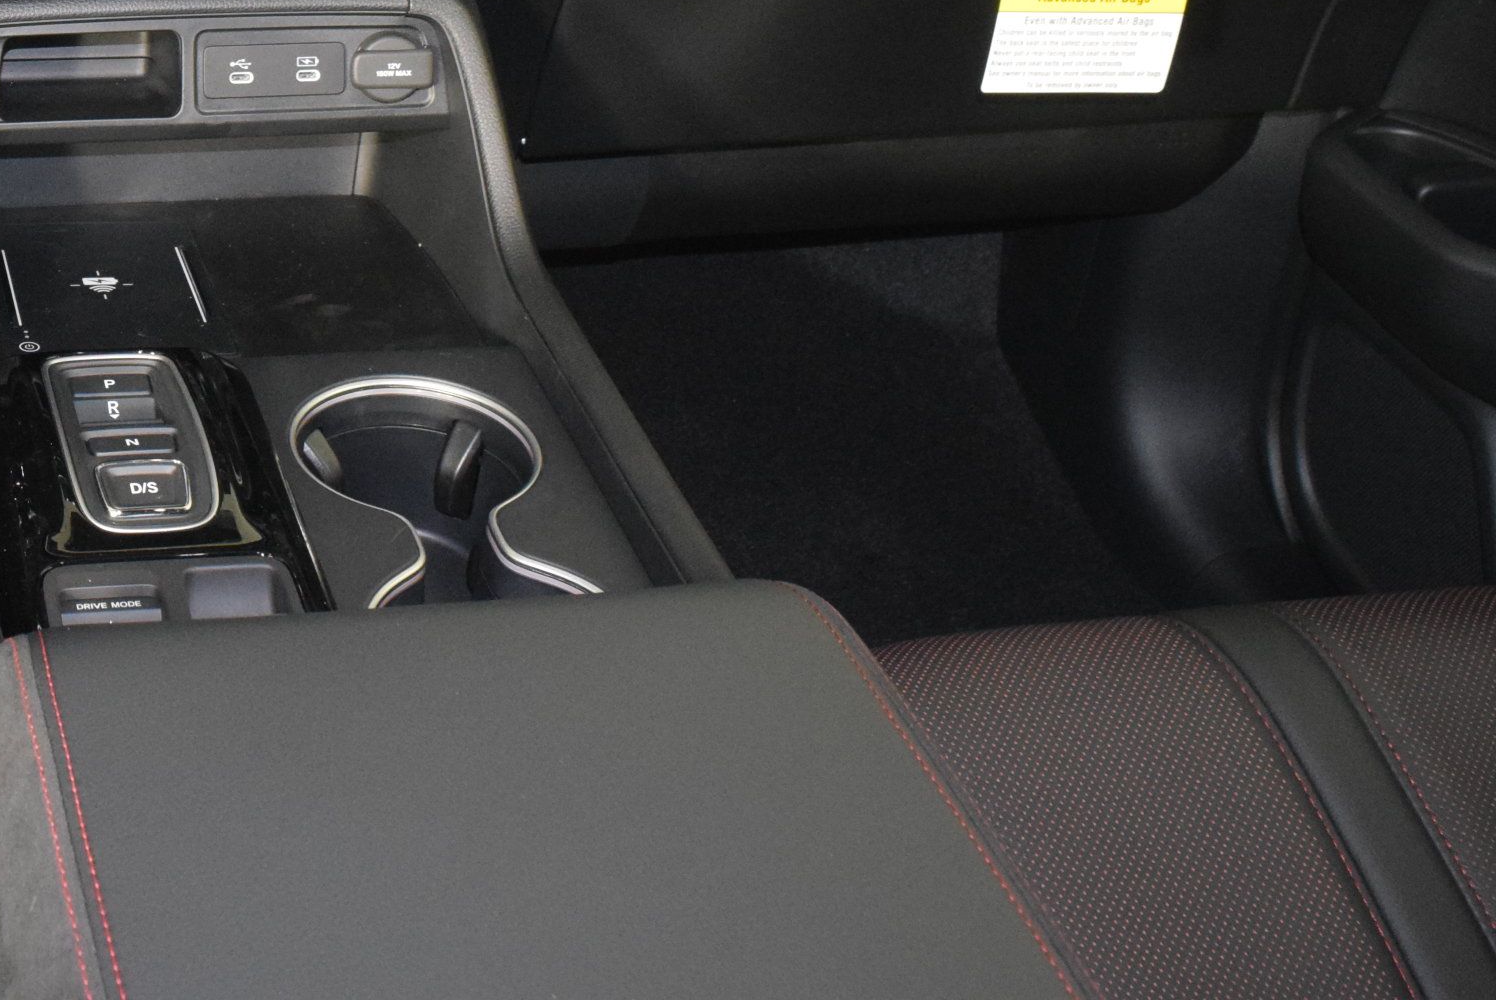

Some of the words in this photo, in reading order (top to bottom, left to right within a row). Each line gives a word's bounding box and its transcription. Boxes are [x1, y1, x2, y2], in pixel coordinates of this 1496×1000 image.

[1024, 16, 1045, 25] Even
[1048, 17, 1068, 25] with
[1070, 16, 1115, 26] Advanced
[1117, 17, 1130, 25] Air
[1132, 16, 1155, 28] Bags
[387, 62, 402, 70] 12V
[395, 69, 412, 77] MAX
[104, 379, 116, 389] P
[107, 401, 120, 414] R
[125, 438, 140, 447] N
[129, 482, 159, 495] D/S
[76, 601, 108, 610] DRIVE
[111, 600, 142, 608] MODE
